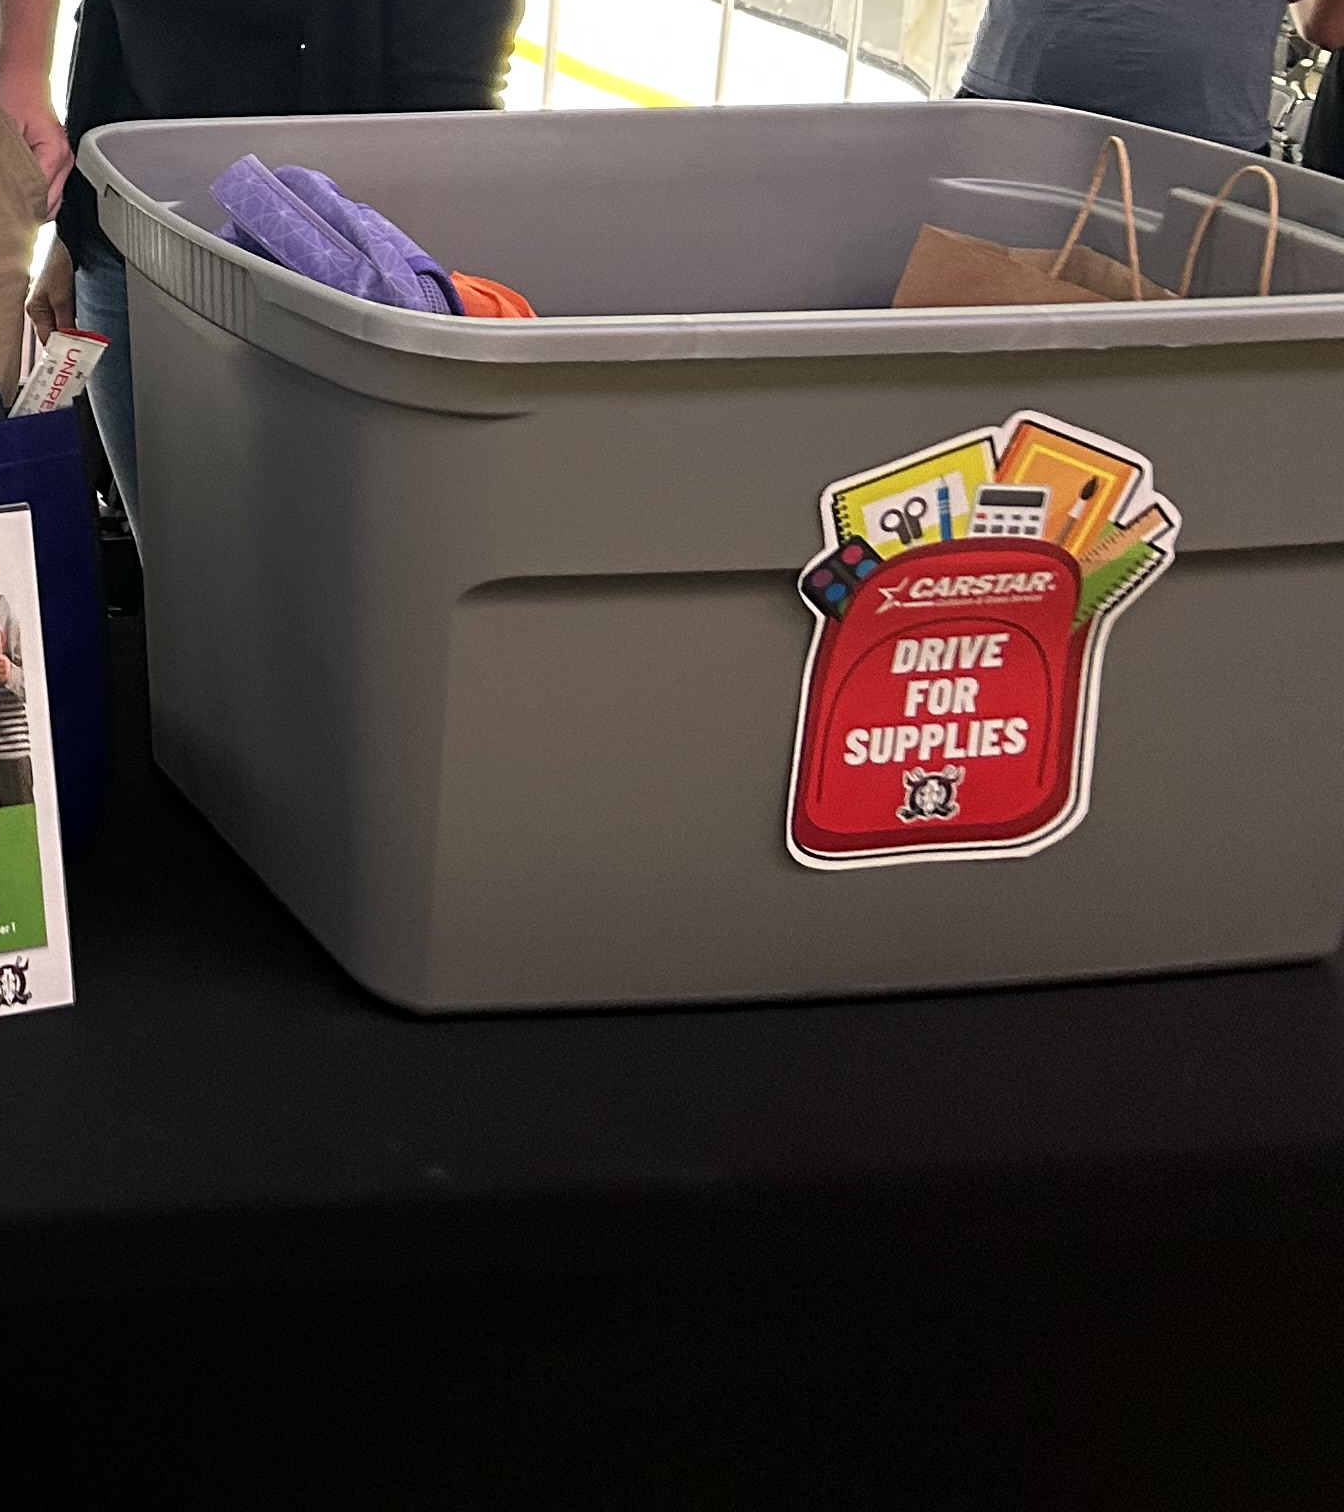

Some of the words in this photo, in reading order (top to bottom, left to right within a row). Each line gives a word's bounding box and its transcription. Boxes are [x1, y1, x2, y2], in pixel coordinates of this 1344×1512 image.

[38, 348, 81, 413] UNBRE
[909, 571, 1054, 599] CARSTAR
[890, 632, 1010, 675] DRIVE
[903, 677, 980, 718] FOR
[843, 717, 1029, 766] SUPPLIES
